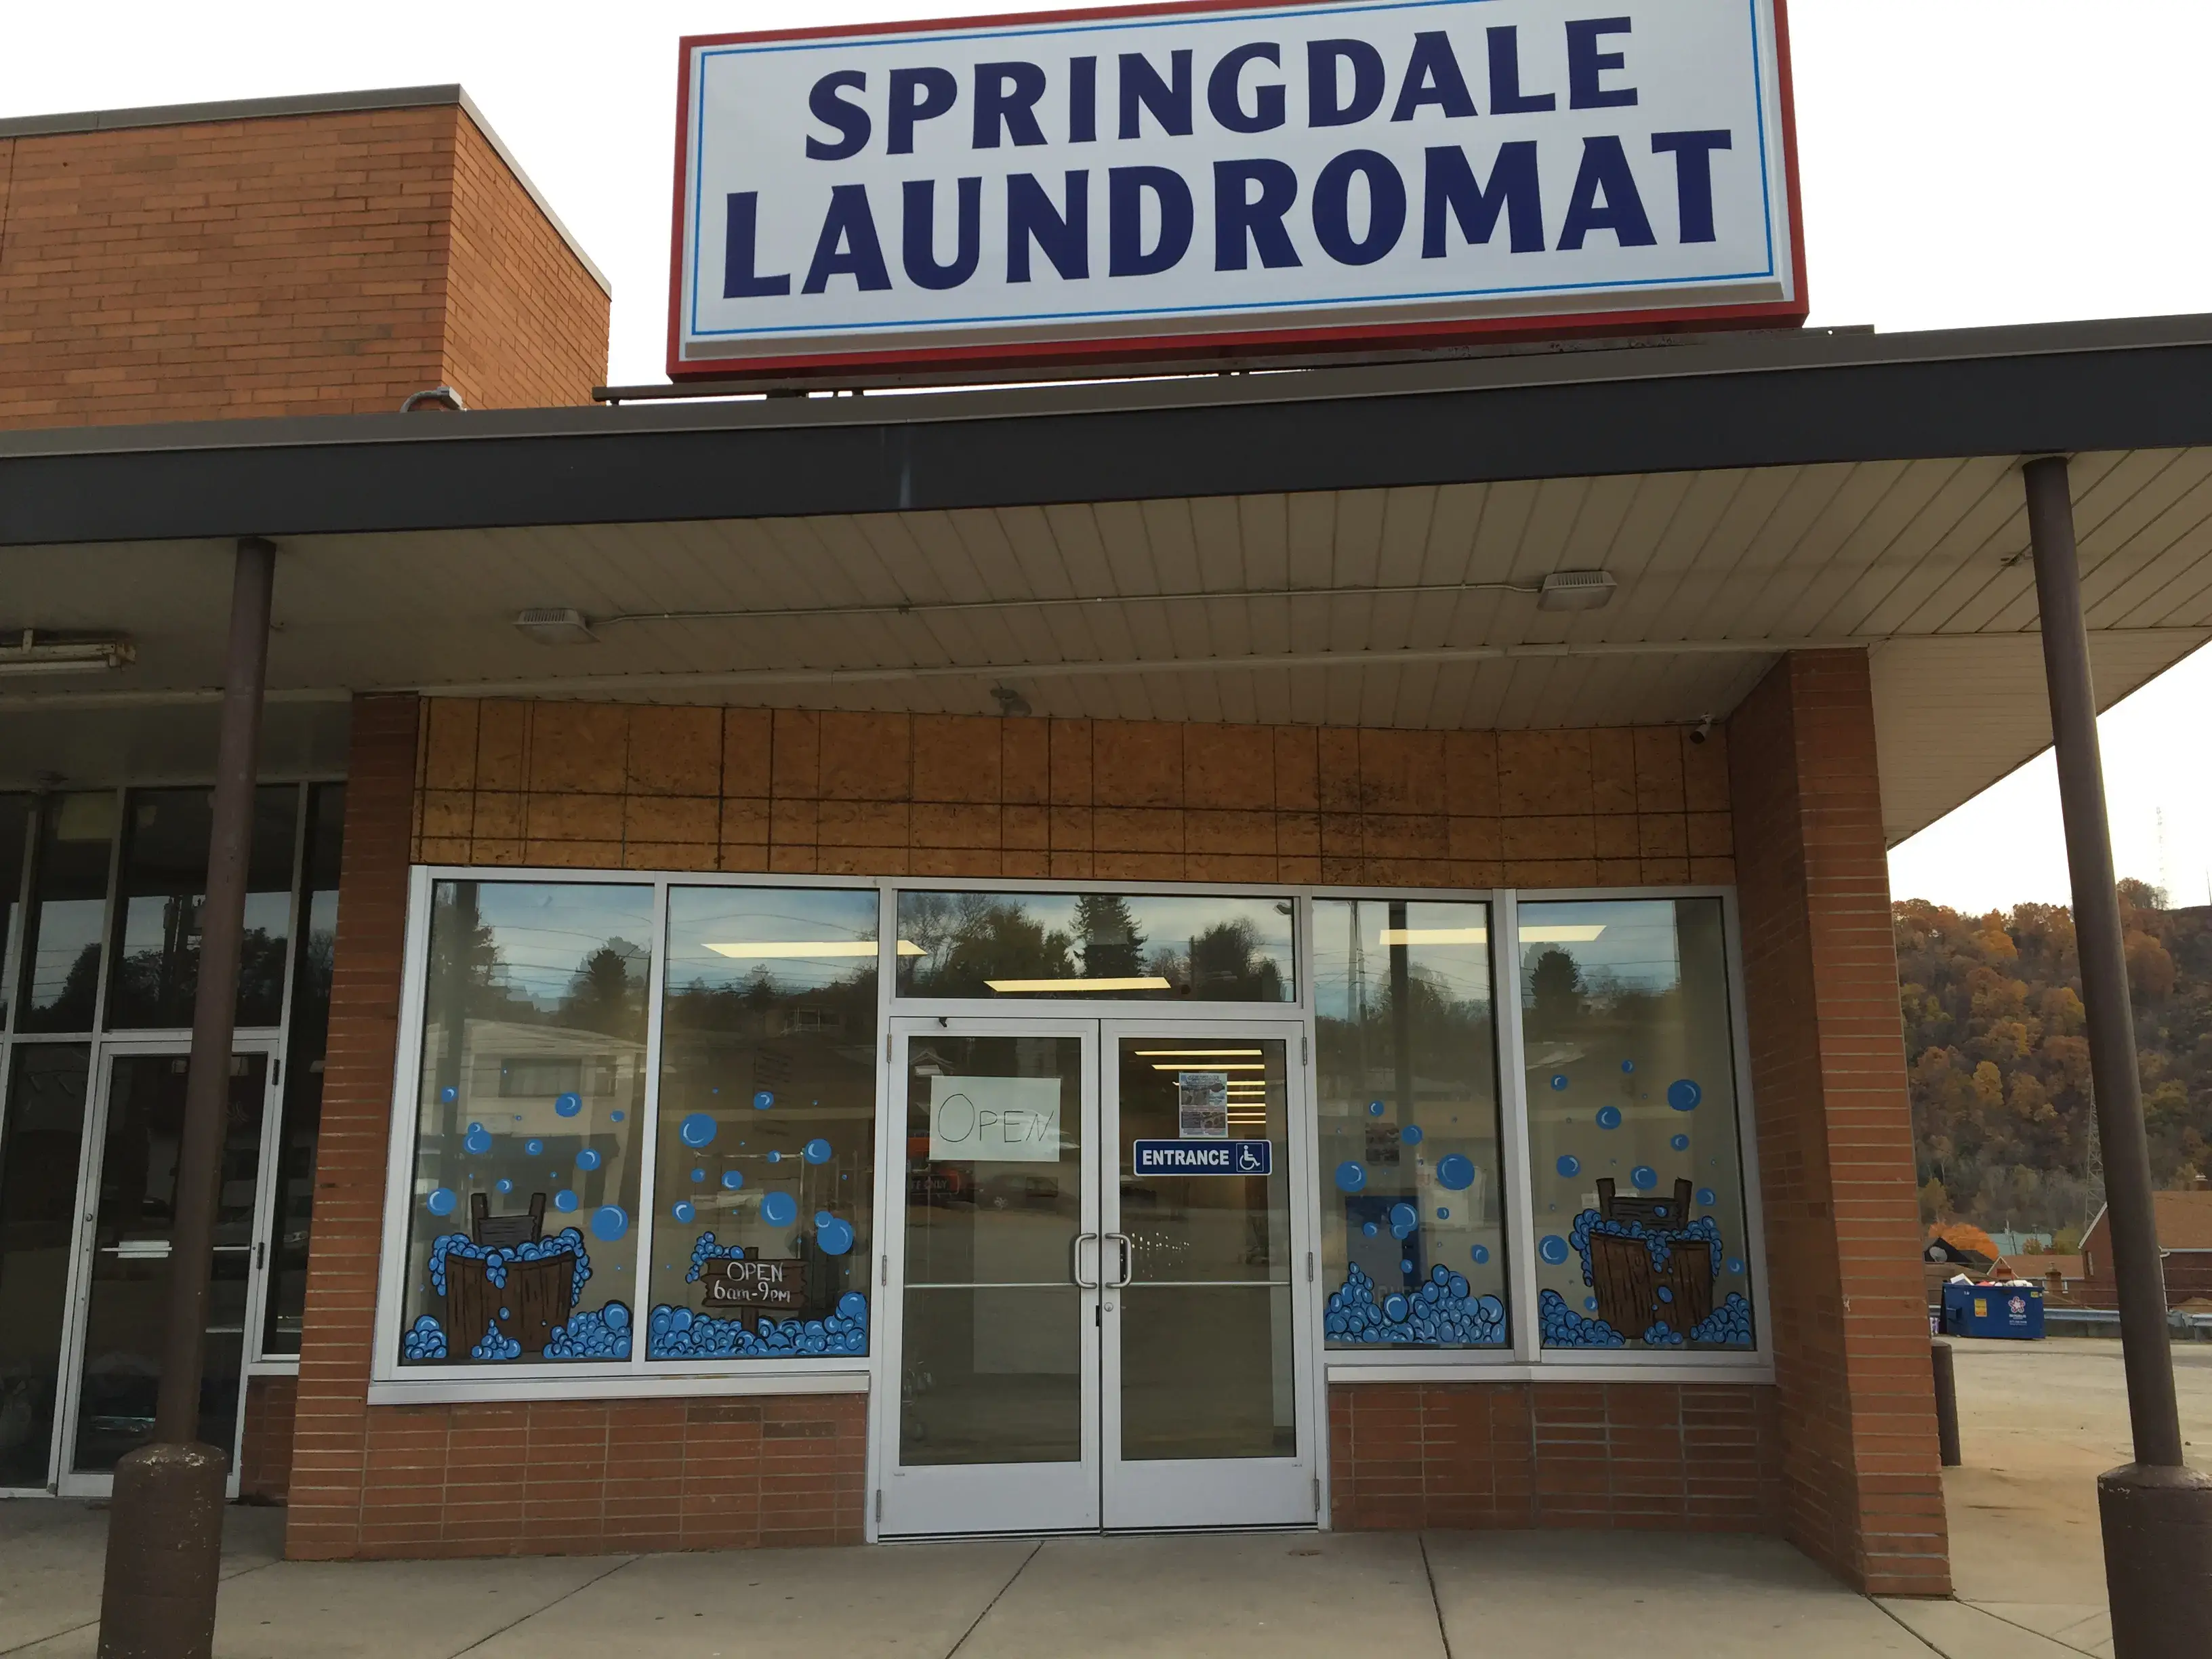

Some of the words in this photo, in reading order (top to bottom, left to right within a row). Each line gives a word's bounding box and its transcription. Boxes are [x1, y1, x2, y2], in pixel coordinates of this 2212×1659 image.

[806, 18, 1637, 161] SPRINGDALE
[724, 131, 1732, 299] LAUNDROMAT
[1142, 1149, 1229, 1166] ENTRANCE
[726, 1261, 784, 1283] OPEN
